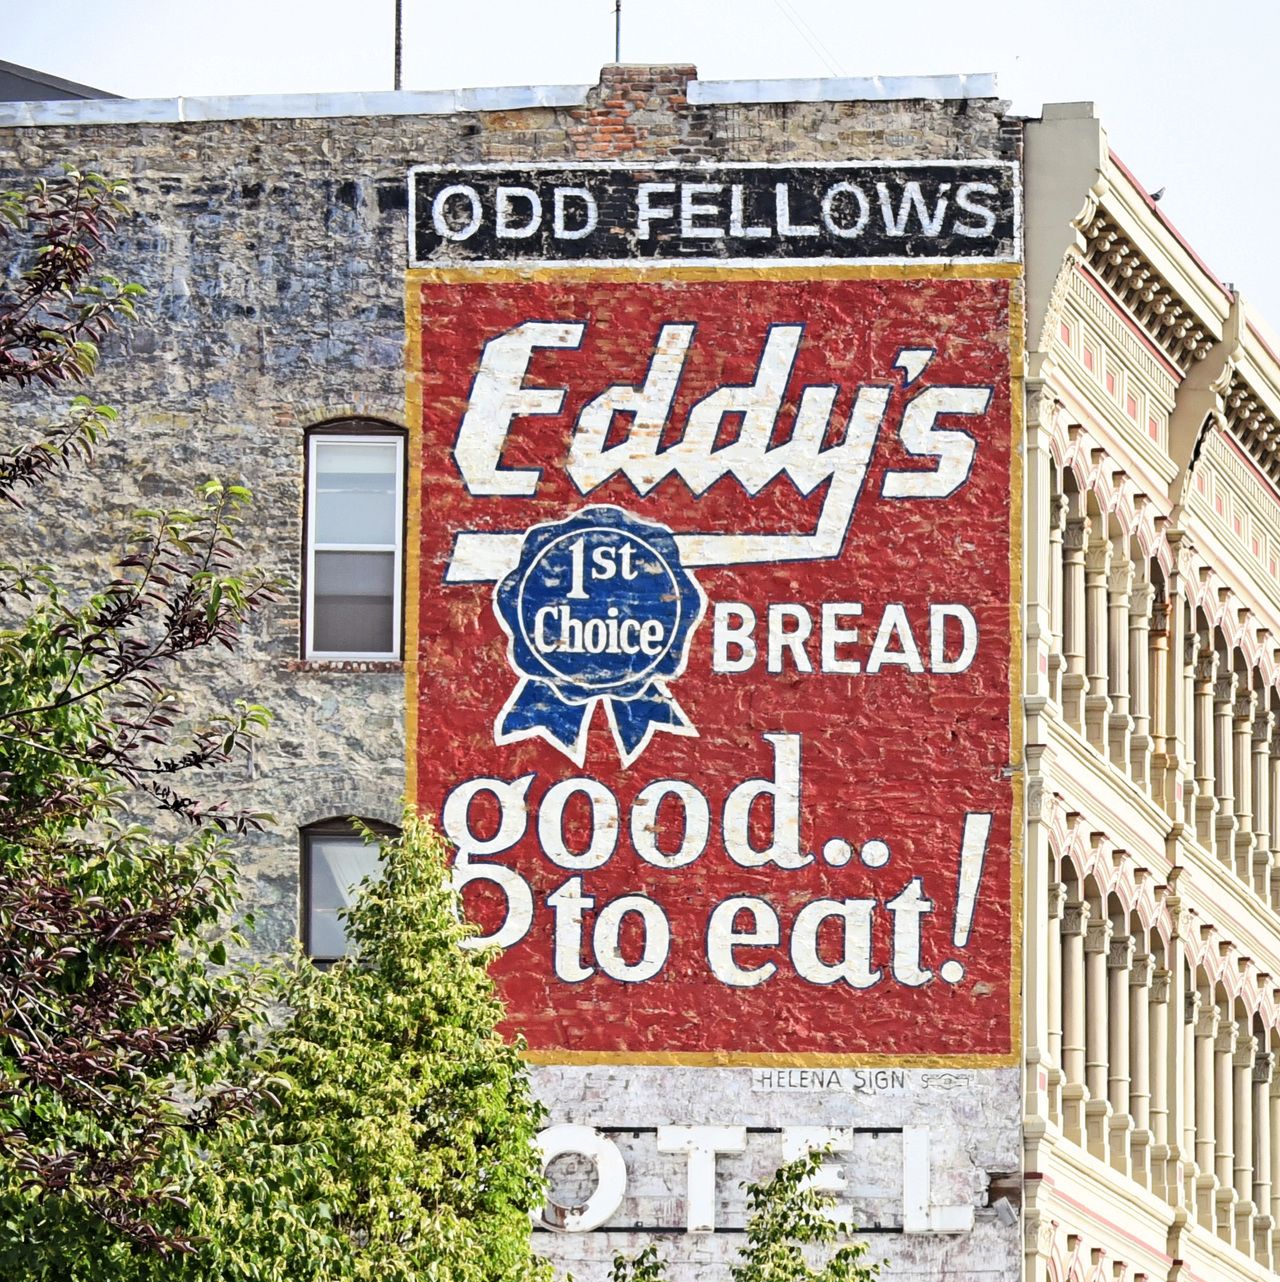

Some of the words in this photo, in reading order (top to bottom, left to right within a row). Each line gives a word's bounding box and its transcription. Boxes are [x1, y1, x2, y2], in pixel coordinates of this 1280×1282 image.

[431, 184, 599, 241] ODD
[635, 181, 997, 239] FELLOWS
[450, 322, 994, 560] Eddy's
[565, 535, 637, 599] 1st
[533, 607, 664, 657] Choice
[712, 602, 978, 674] BREAD
[546, 876, 670, 985] to
[705, 812, 993, 988] eat!
[761, 1071, 842, 1089] HELENA
[854, 1070, 905, 1090] SIGN
[533, 1124, 975, 1233] OTEL
